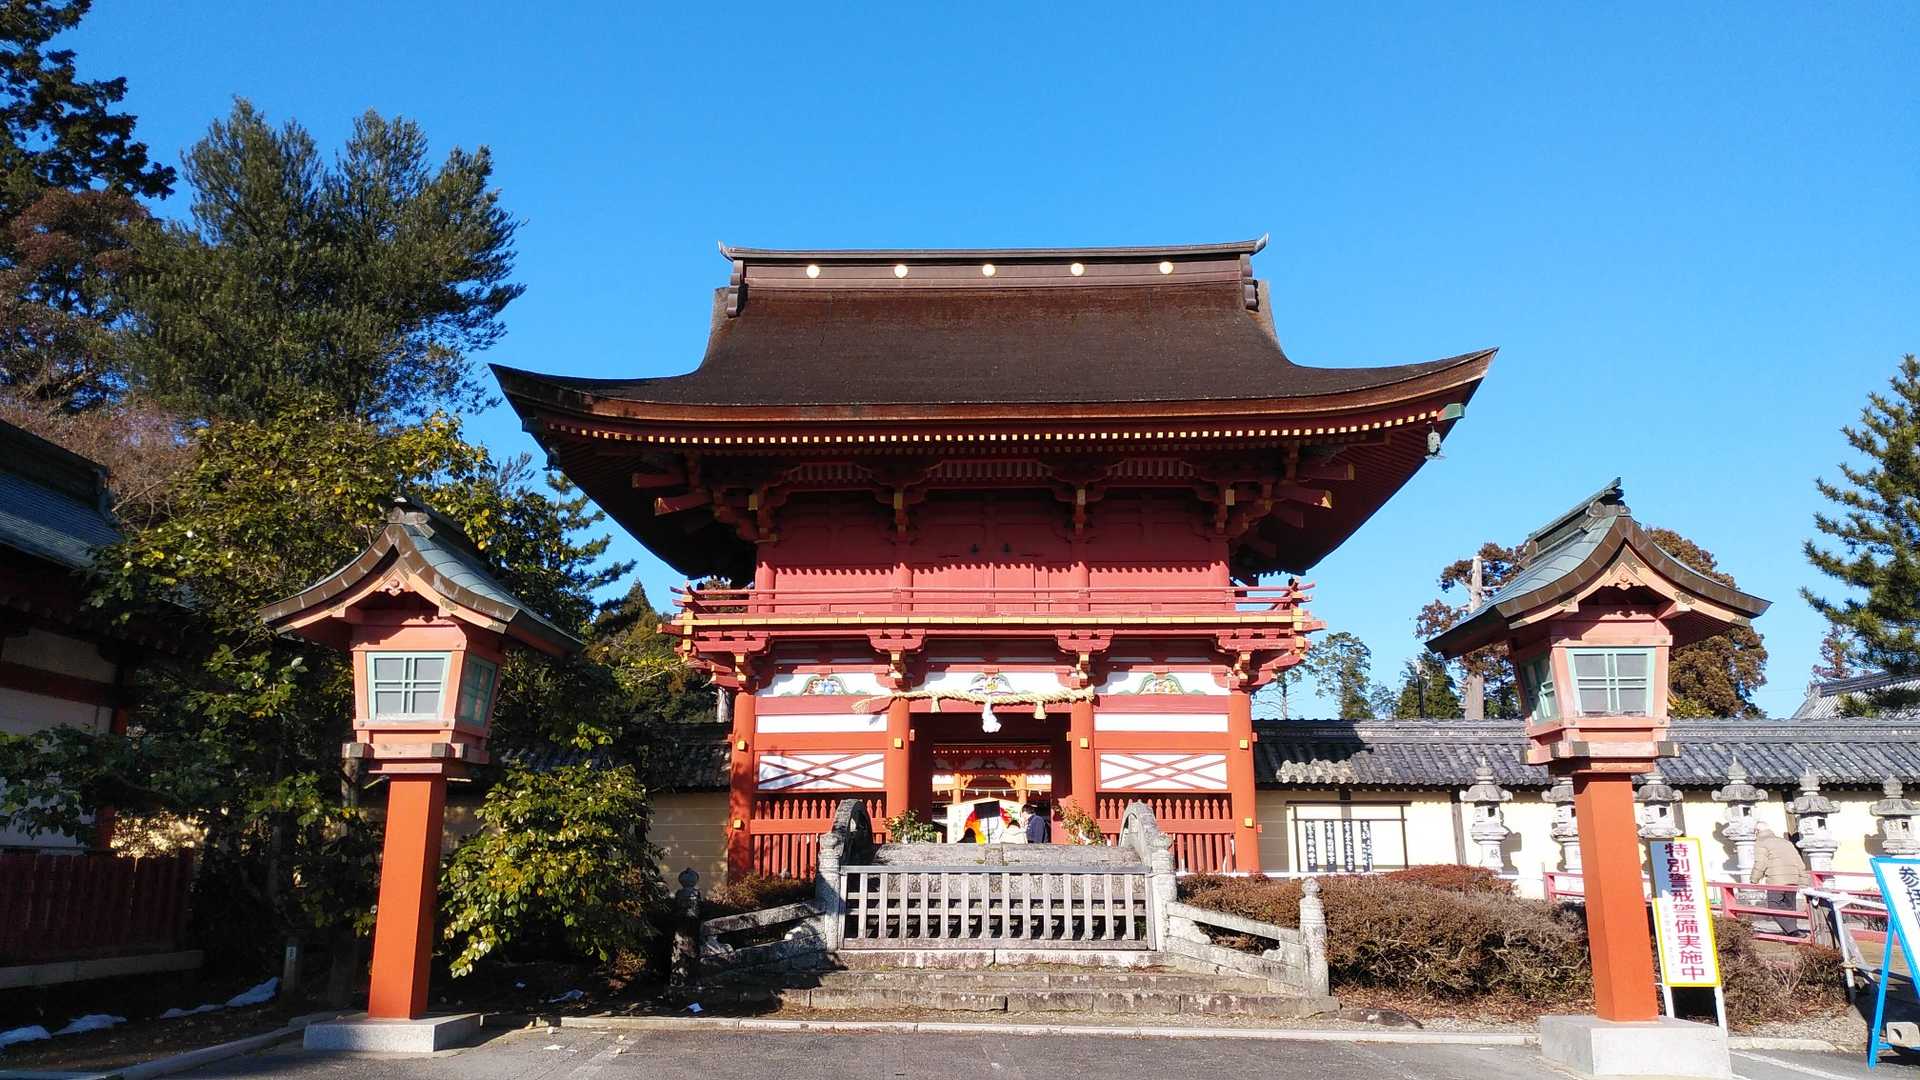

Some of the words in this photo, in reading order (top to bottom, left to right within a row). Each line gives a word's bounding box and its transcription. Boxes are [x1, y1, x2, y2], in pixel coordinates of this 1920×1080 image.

[1664, 842, 1705, 981] 特別警戒警備実施中
